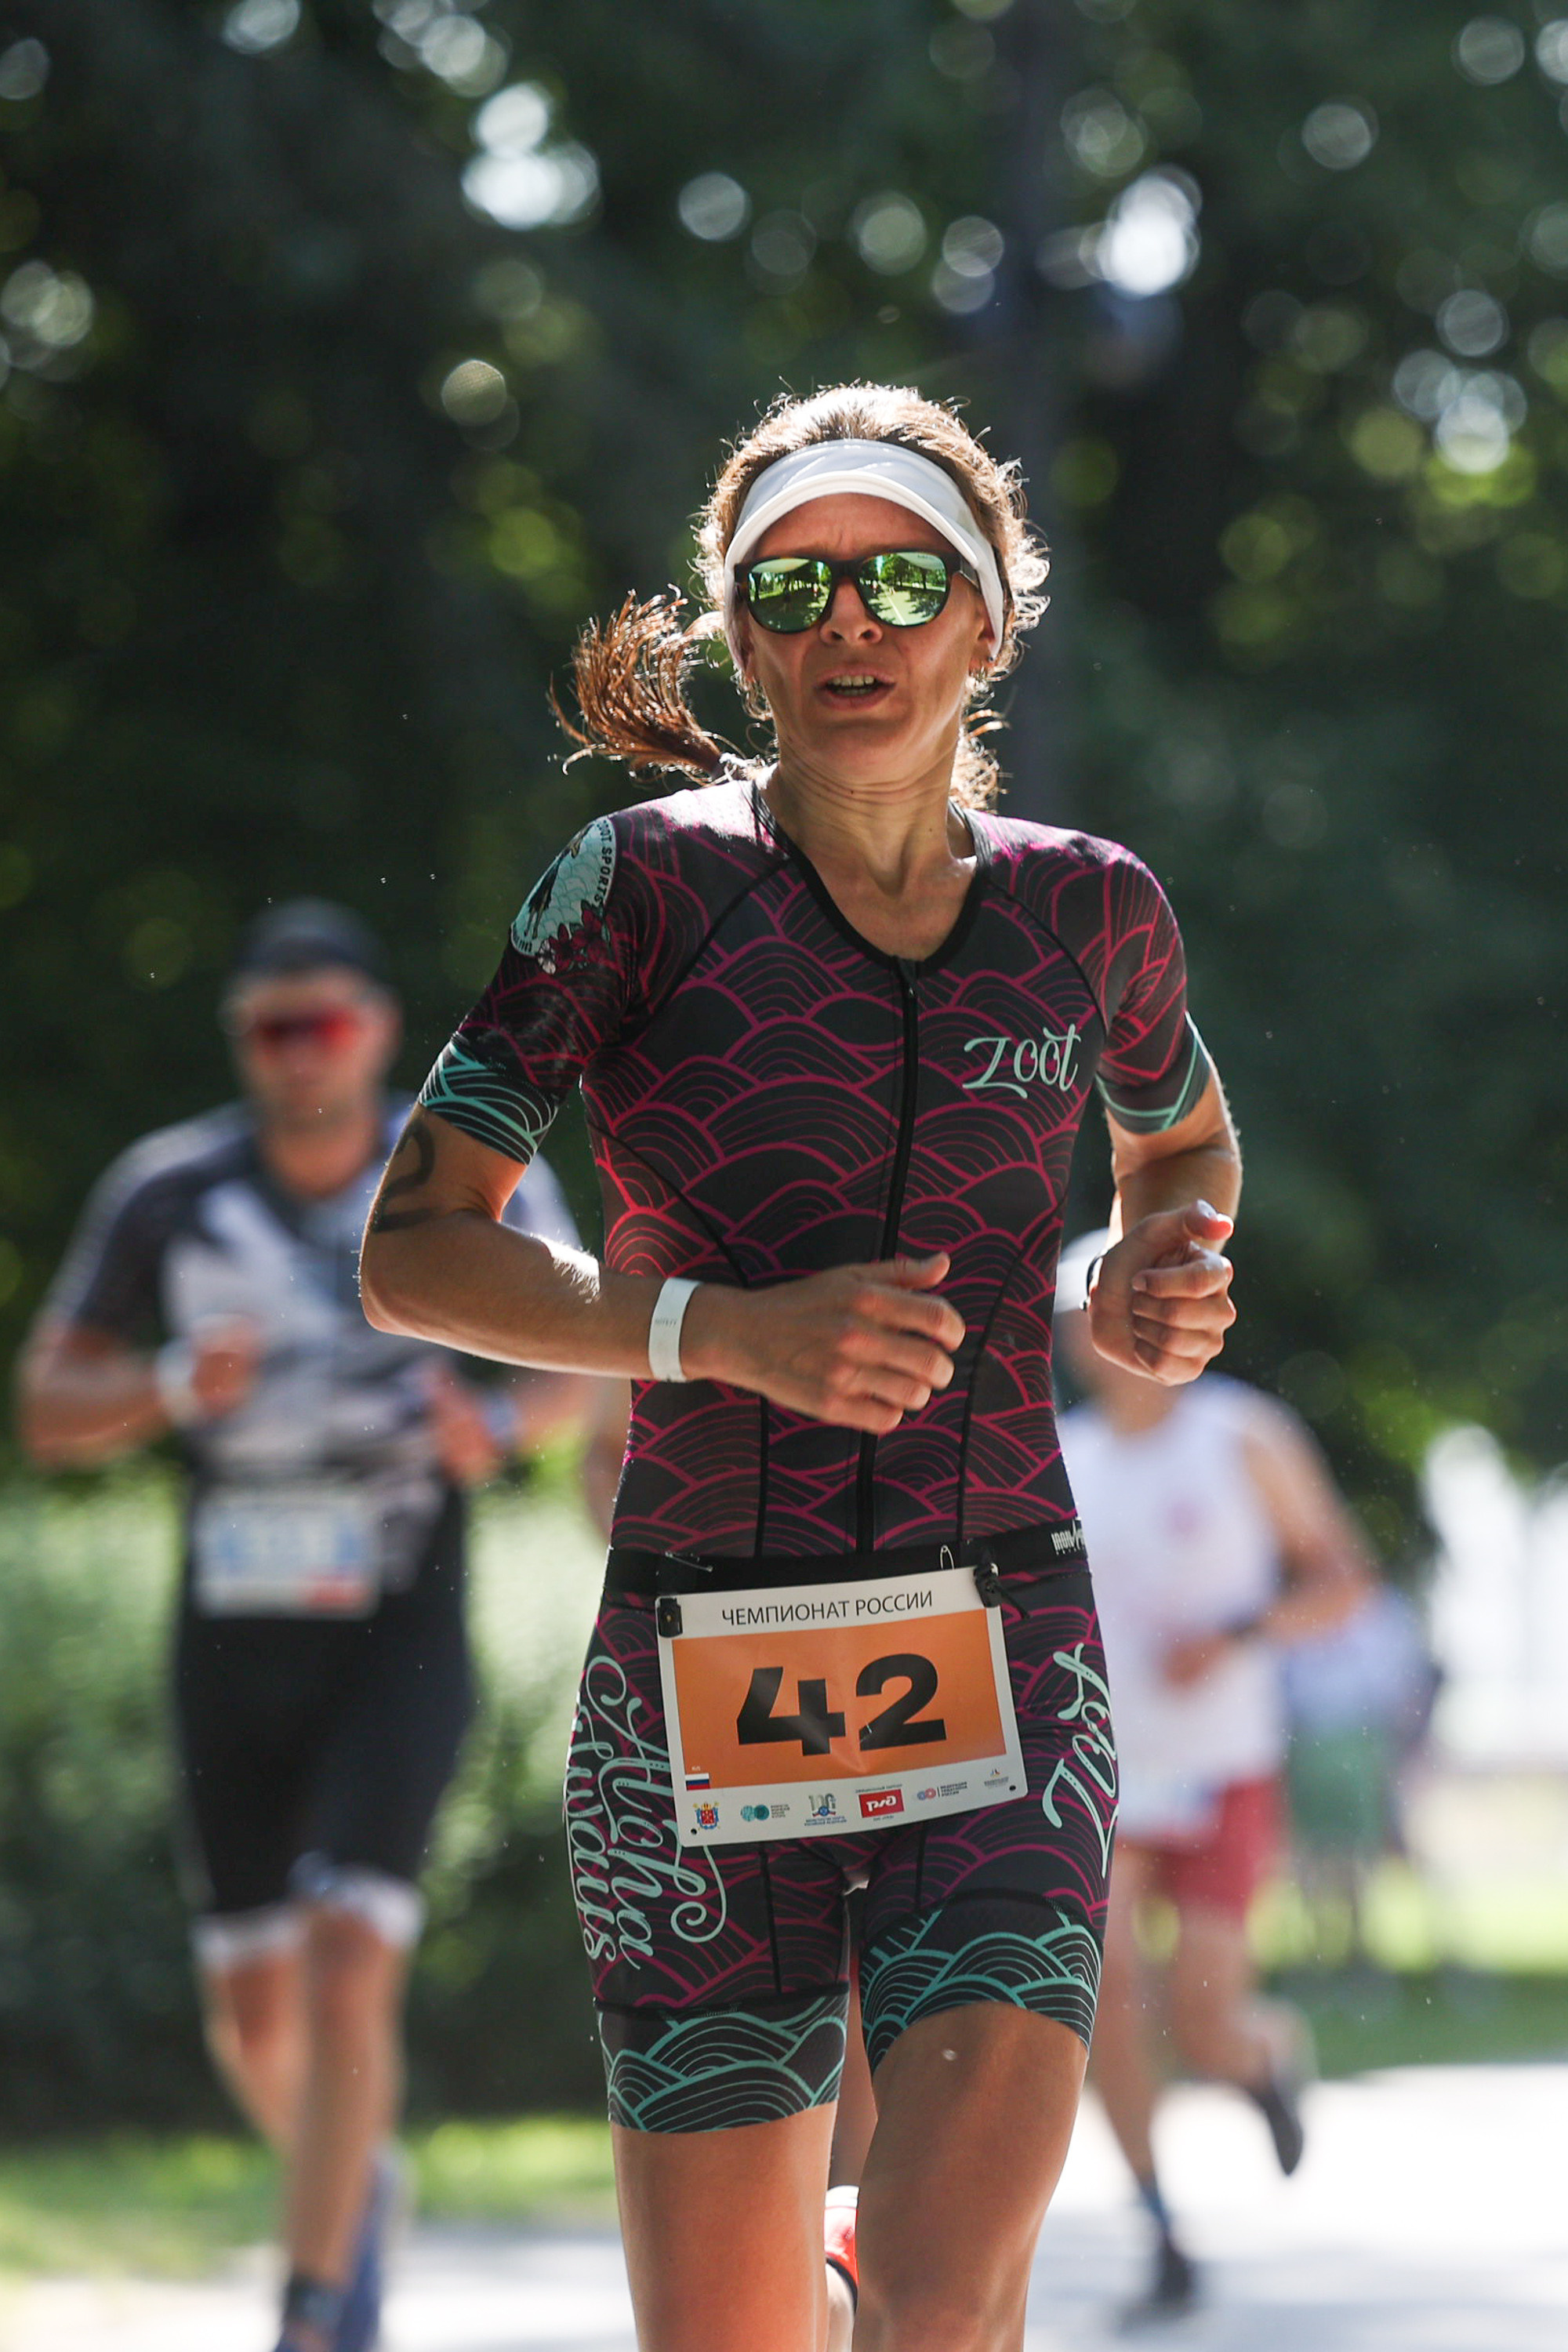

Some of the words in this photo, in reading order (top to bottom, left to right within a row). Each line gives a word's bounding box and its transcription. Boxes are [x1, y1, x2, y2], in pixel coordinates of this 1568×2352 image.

[594, 847, 612, 907] SPORTS
[962, 1023, 1082, 1099] Zoot
[721, 1600, 850, 1626] ЧЕМПИОНАТ
[855, 1590, 933, 1617] РОССИИ
[736, 1653, 947, 1756] 42
